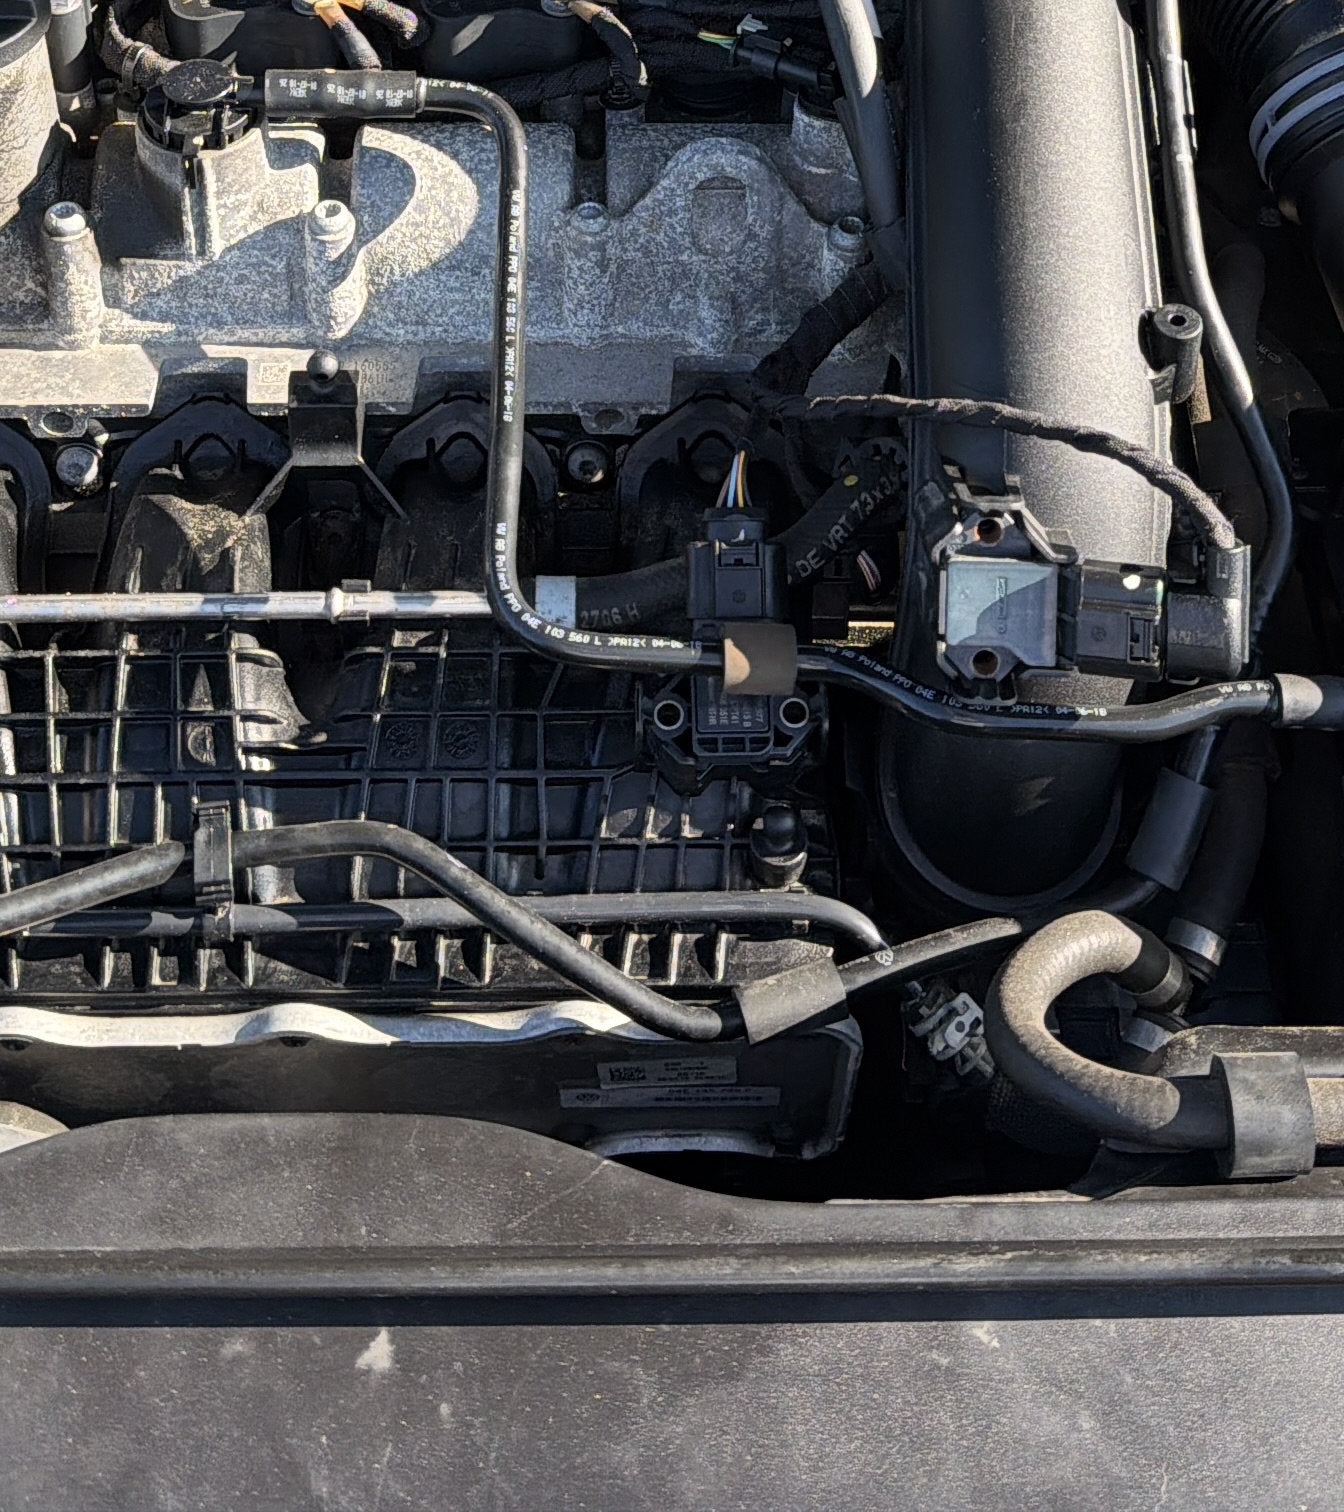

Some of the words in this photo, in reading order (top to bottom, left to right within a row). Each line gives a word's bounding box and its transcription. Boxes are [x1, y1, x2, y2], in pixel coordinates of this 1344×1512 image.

[508, 219, 519, 252] Poland
[795, 547, 825, 578] DE
[495, 554, 511, 590] Poland
[521, 612, 543, 630] 04E
[544, 625, 565, 639] 103
[567, 632, 591, 644] 560
[594, 637, 602, 646] L
[626, 602, 641, 623] H
[856, 653, 892, 679] Poland
[914, 686, 936, 701] 04E
